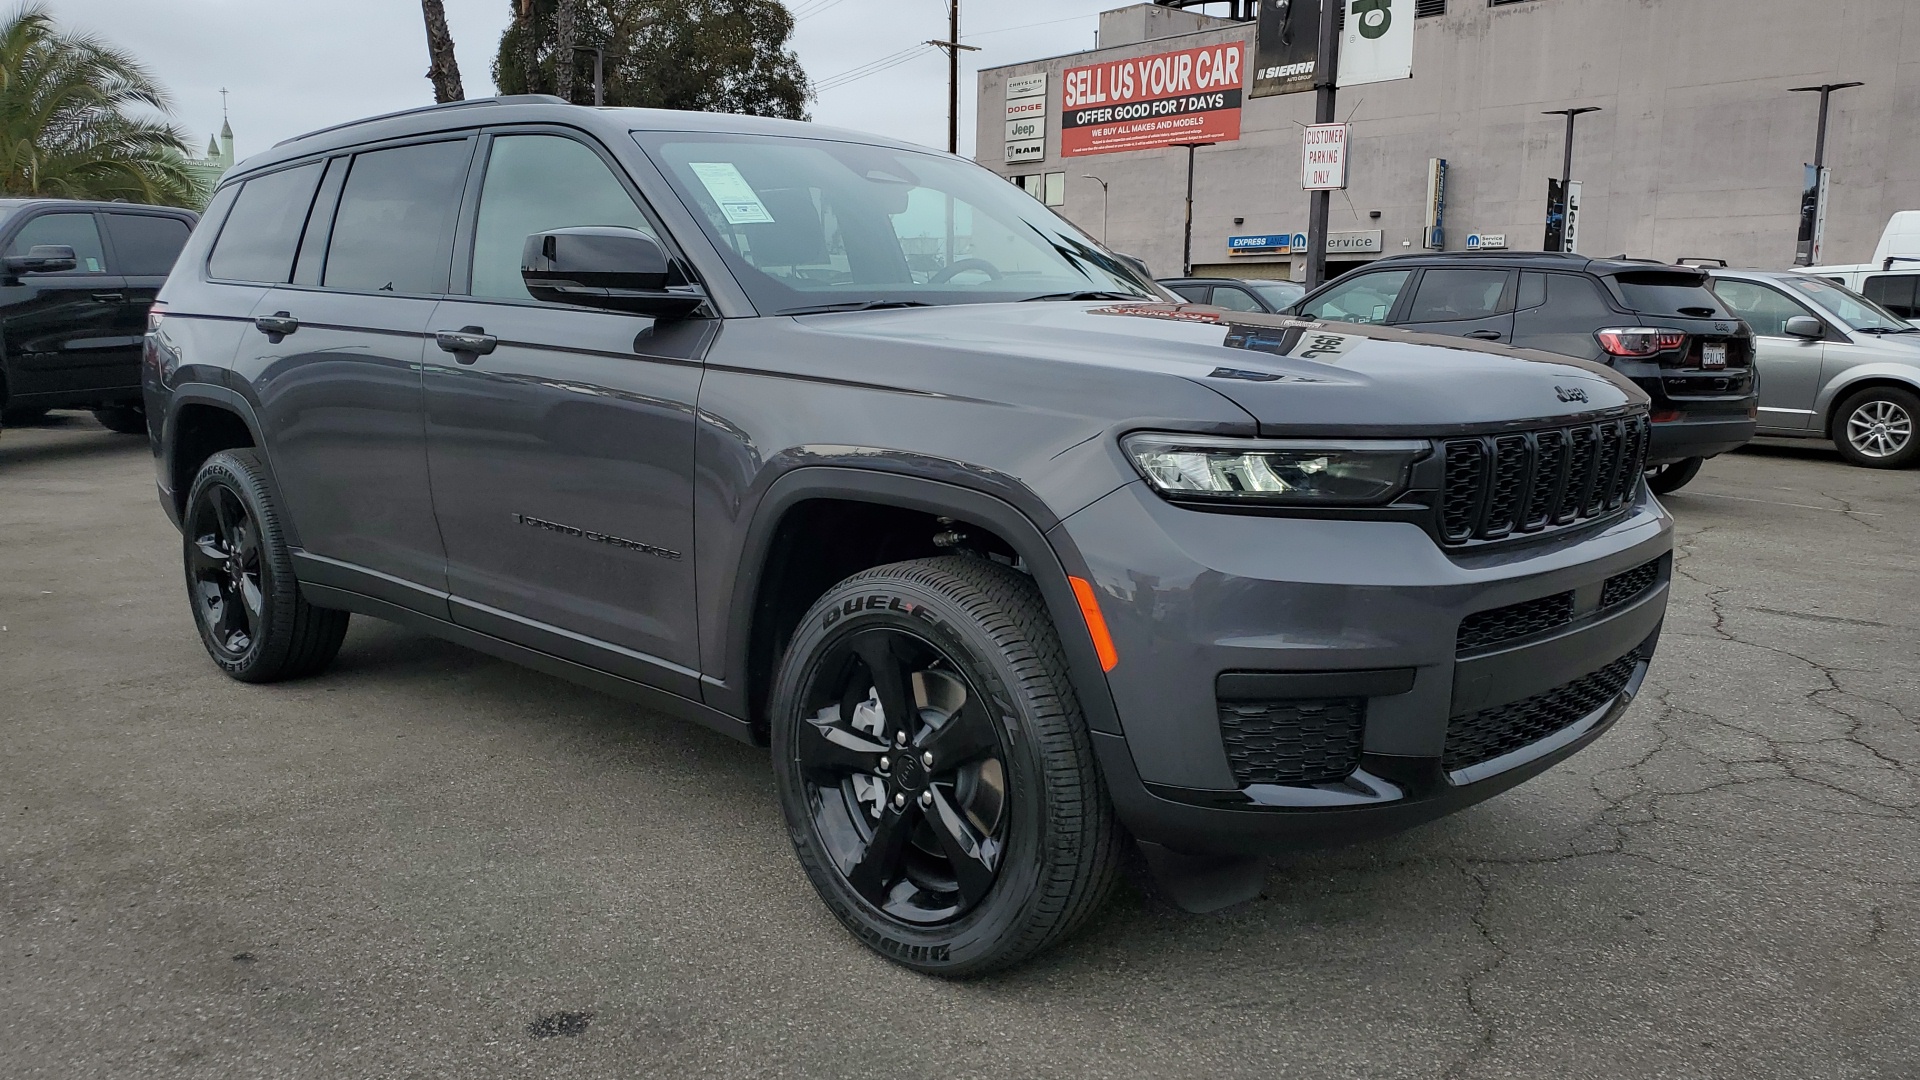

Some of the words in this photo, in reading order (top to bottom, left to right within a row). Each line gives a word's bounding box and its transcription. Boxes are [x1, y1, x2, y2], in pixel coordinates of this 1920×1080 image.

[1066, 68, 1106, 107] SELL
[1110, 63, 1134, 100] US
[1138, 54, 1192, 96] YOUR
[1196, 47, 1239, 88] CAR
[1265, 61, 1315, 78] SIERRA
[1009, 79, 1042, 87] CHRYSLER
[1008, 103, 1042, 113] DODGE
[1076, 109, 1112, 125] OFFER
[1114, 104, 1150, 120] GOOD
[1152, 100, 1177, 115] FOR
[1179, 98, 1187, 112] 7
[1188, 93, 1224, 110] DAYS
[1012, 123, 1035, 136] Jeep
[1091, 128, 1102, 138] WE
[1103, 126, 1117, 136] BUY
[1118, 124, 1130, 134] ALL
[1131, 121, 1155, 132] MAKES
[1156, 119, 1172, 130] AND
[1173, 116, 1204, 127] MODELS
[1307, 129, 1343, 145] CUSTOMER
[1016, 146, 1041, 154] RAM
[1309, 149, 1338, 164] PARKING
[1313, 170, 1330, 185] ONLY
[1566, 195, 1579, 253] Jeep
[1234, 237, 1266, 247] EXPRESS
[1327, 236, 1372, 248] ervice
[1554, 385, 1589, 403] Jeep
[526, 516, 582, 537] GRAND
[585, 530, 682, 561] CHEROKEE
[822, 595, 963, 643] DUELER
